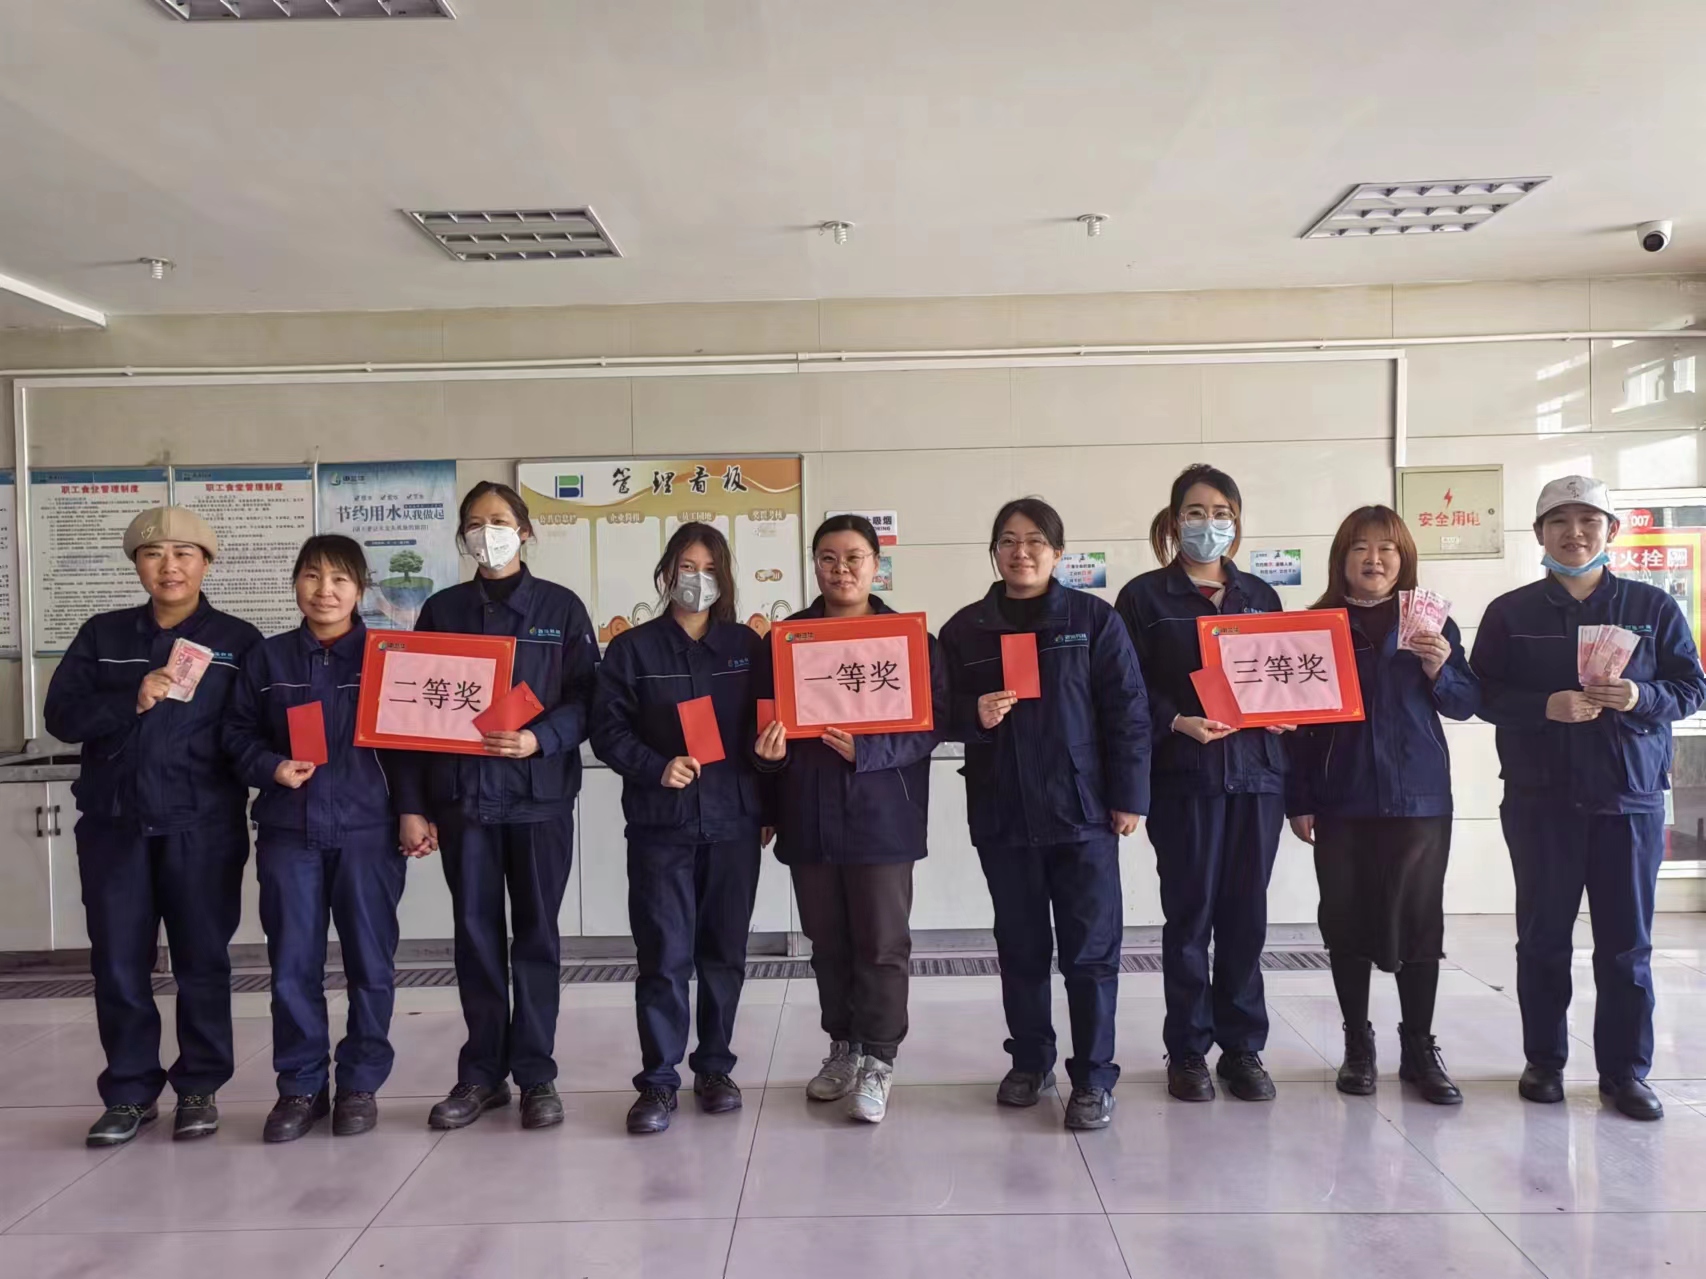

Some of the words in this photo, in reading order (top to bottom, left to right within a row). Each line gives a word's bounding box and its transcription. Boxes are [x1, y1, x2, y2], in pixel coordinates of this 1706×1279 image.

[205, 483, 284, 492] 职工食堂管理制度
[612, 466, 748, 494] 管理看板
[336, 504, 402, 523] 节约用水
[402, 509, 444, 520] 从我做起
[1418, 511, 1481, 527] 安全用电
[1631, 515, 1650, 526] 007
[804, 660, 901, 693] 一等奖
[1233, 653, 1329, 684] 三等奖
[389, 678, 482, 713] 二等奖
